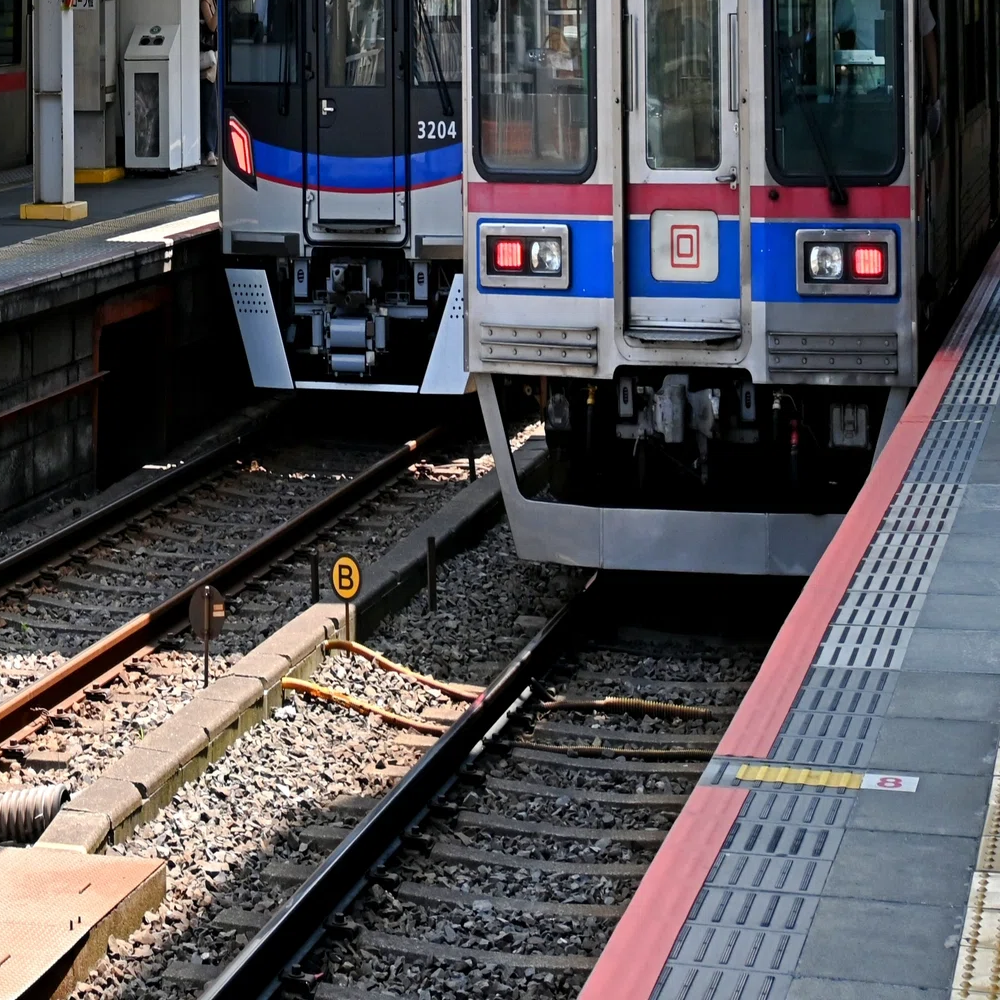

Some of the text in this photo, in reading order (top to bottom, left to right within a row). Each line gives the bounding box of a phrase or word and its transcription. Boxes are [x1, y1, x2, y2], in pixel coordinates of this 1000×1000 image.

[417, 120, 457, 139] 3204
[338, 563, 354, 590] B
[876, 776, 903, 789] 8
